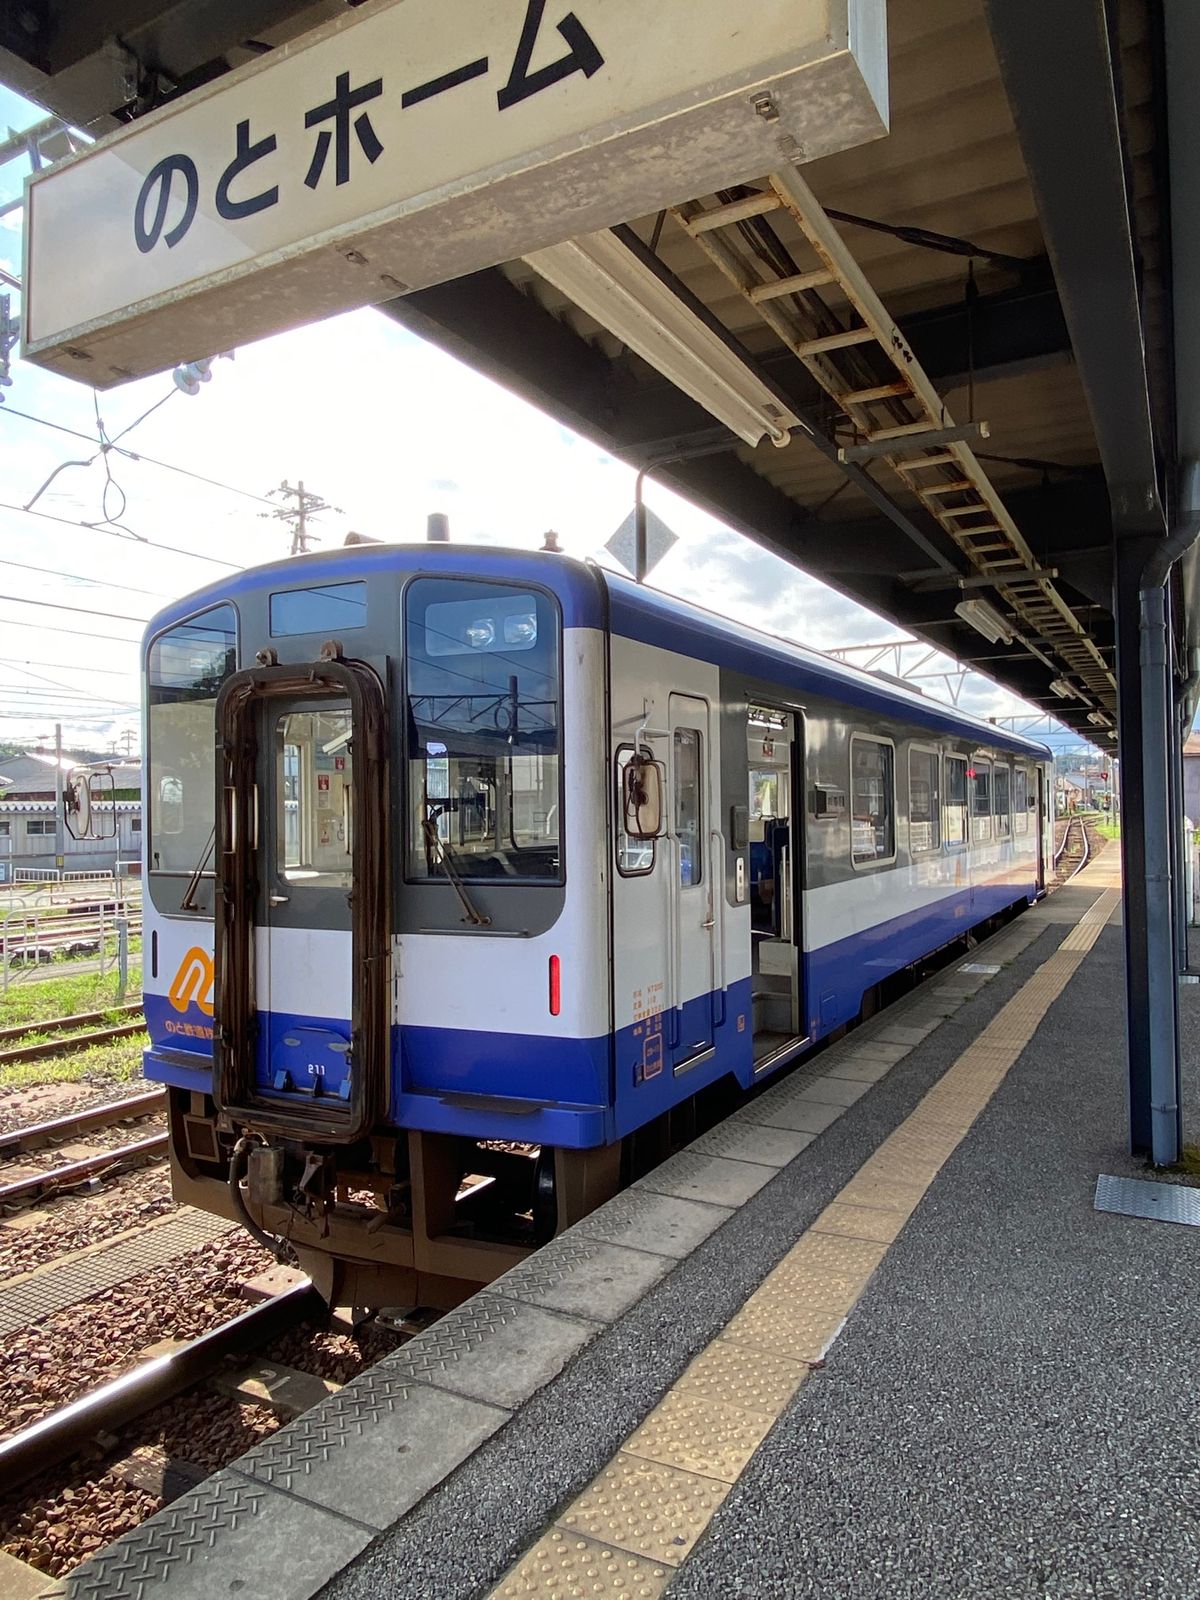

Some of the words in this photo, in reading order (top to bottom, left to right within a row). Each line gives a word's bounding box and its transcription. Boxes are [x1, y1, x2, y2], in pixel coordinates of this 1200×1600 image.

[135, 0, 604, 253] のとホーム
[308, 1063, 325, 1076] 211
